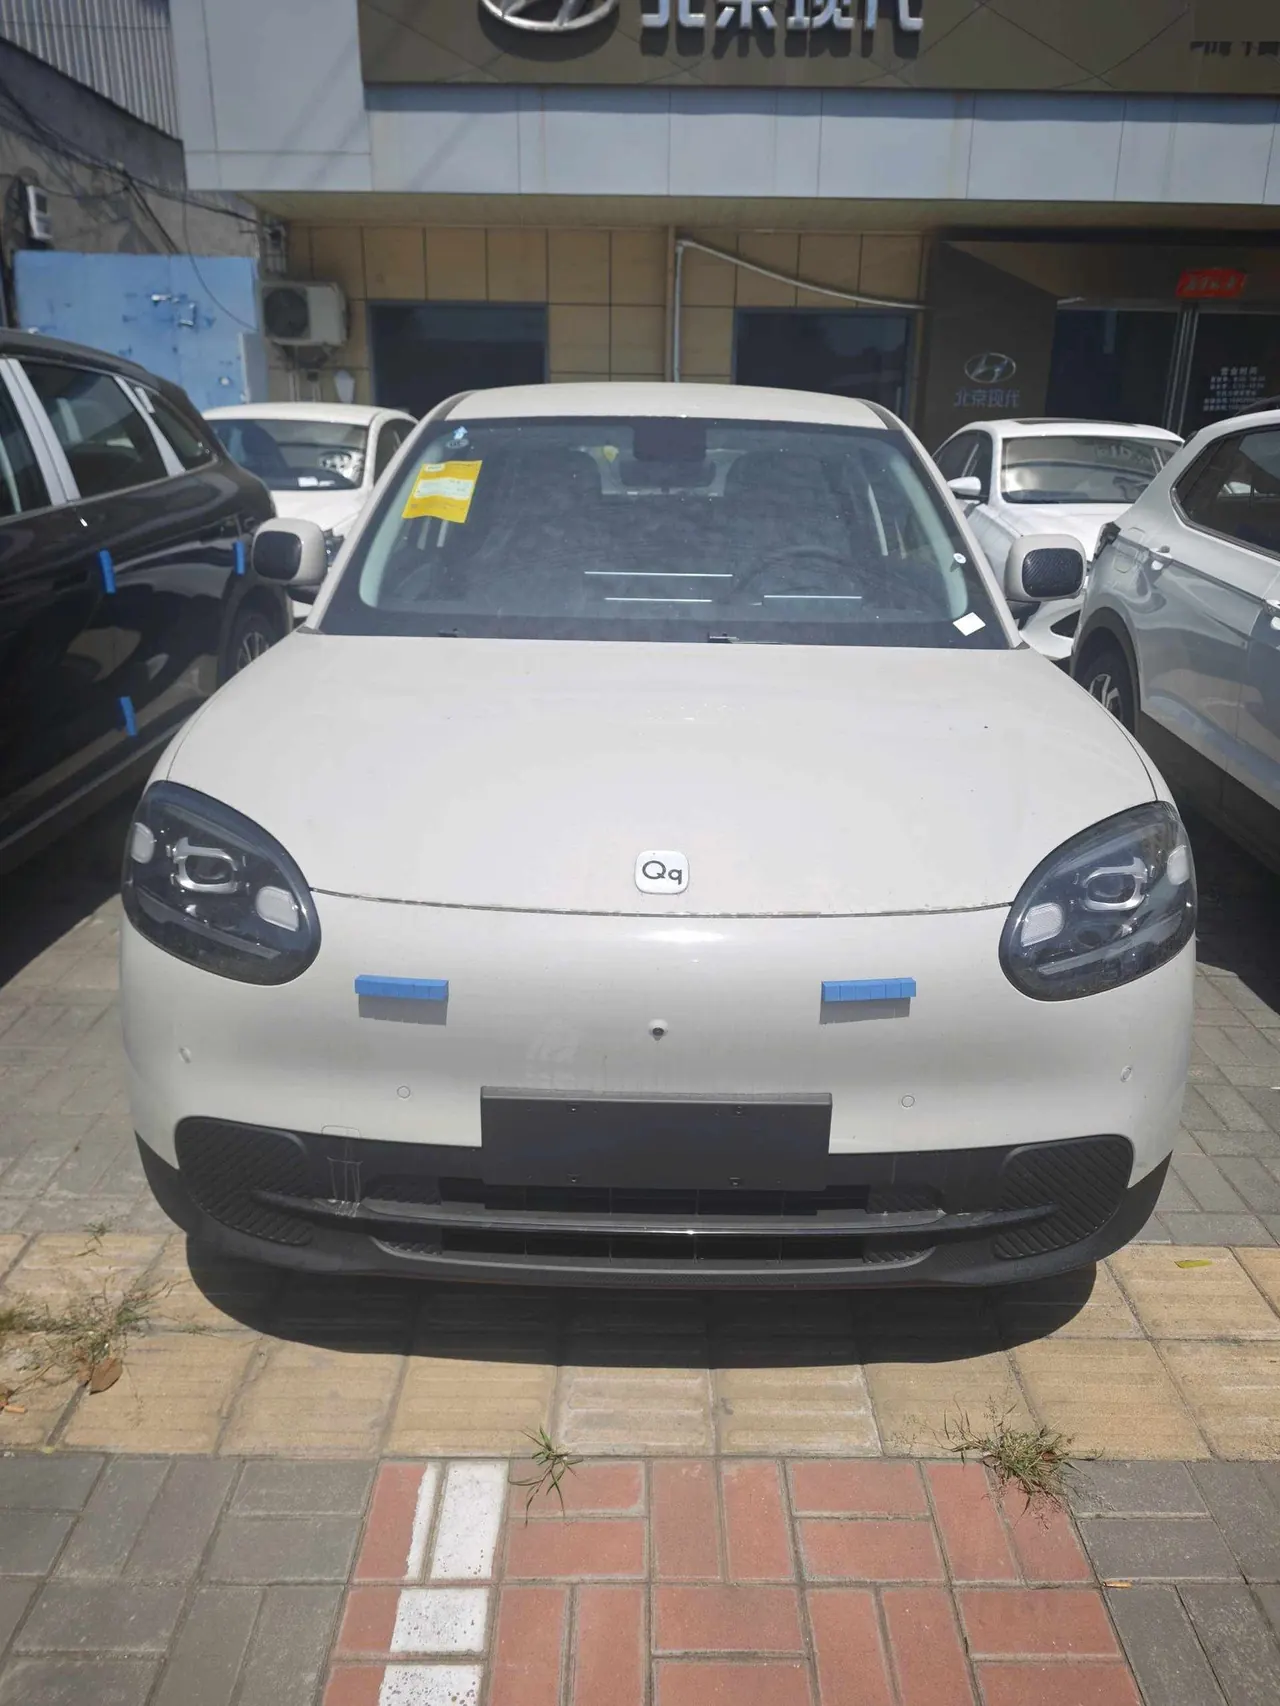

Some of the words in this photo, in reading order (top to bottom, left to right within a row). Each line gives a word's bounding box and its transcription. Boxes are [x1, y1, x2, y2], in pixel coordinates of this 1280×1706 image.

[954, 388, 1020, 408] 北京现代
[641, 859, 683, 886] Qq
